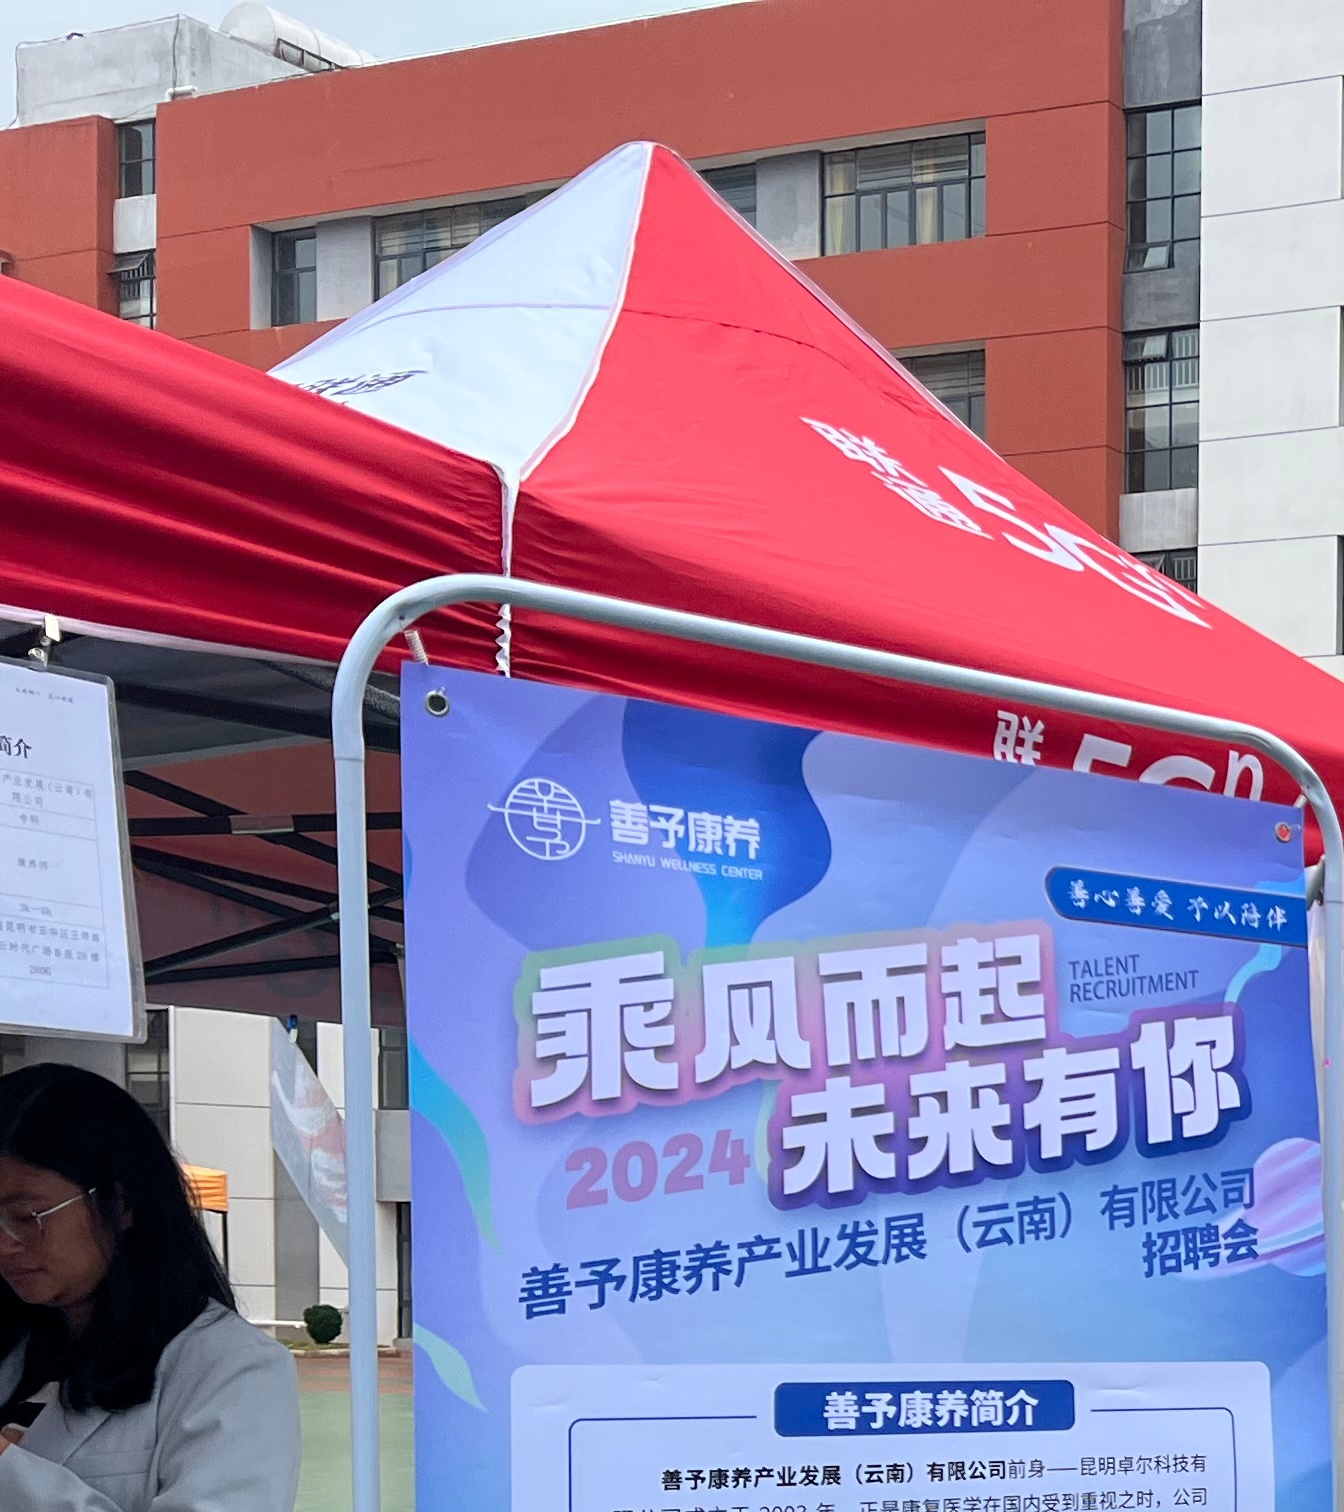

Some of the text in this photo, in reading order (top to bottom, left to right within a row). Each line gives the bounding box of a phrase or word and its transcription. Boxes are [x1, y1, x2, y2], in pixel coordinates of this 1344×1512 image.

[609, 799, 761, 860] 善予康养
[612, 850, 763, 881] SHANYU WELLNESS CENTER
[1069, 953, 1140, 980] TALENT
[1070, 969, 1199, 1003] RECRUITMENT
[530, 932, 1049, 1109] 乘风而起
[780, 1015, 1245, 1198] 未来有你
[563, 1135, 750, 1210] 2024
[517, 1165, 1256, 1320] 善予康养产业发展（云南）有限公司
[1142, 1218, 1260, 1280] 招聘会
[822, 1388, 1040, 1431] 善予康养简介
